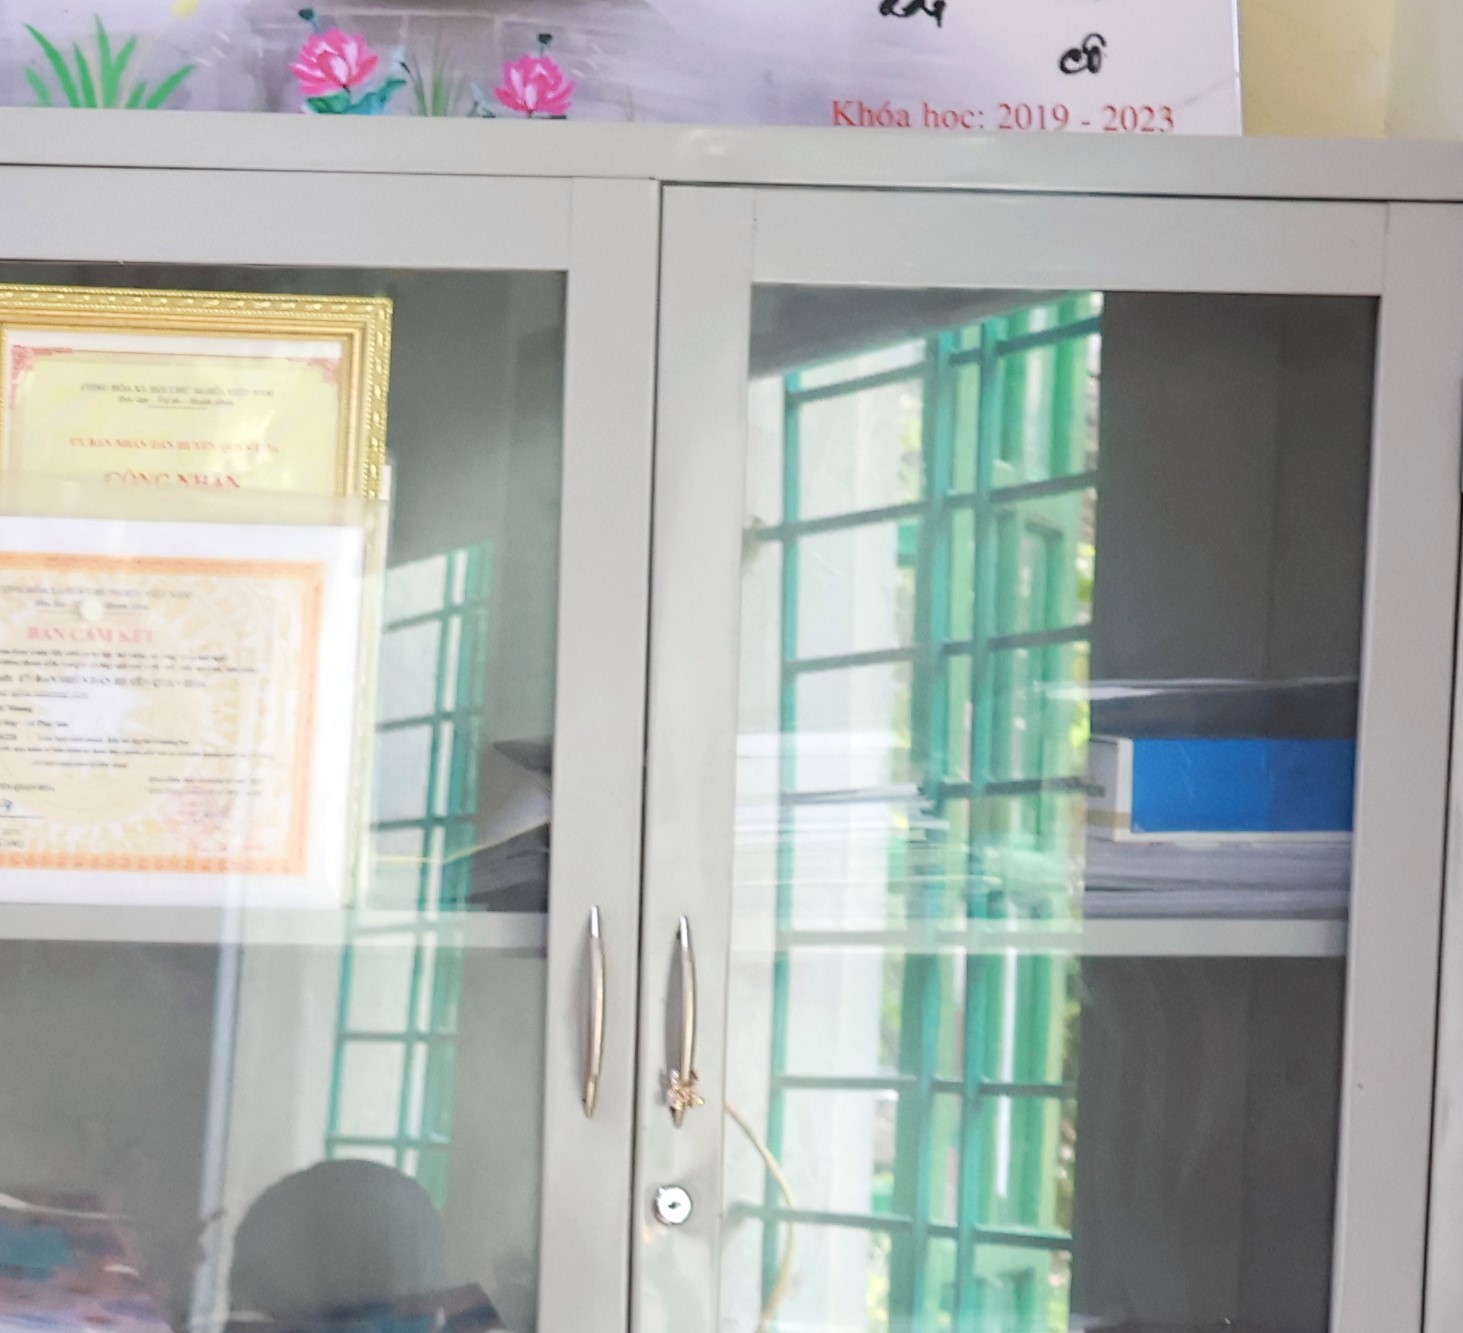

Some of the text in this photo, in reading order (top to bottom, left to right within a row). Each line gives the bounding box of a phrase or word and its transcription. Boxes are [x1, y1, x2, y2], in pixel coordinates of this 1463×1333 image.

[831, 99, 912, 128] Khóa
[998, 103, 1070, 131] 2019
[1102, 105, 1176, 133] 2023
